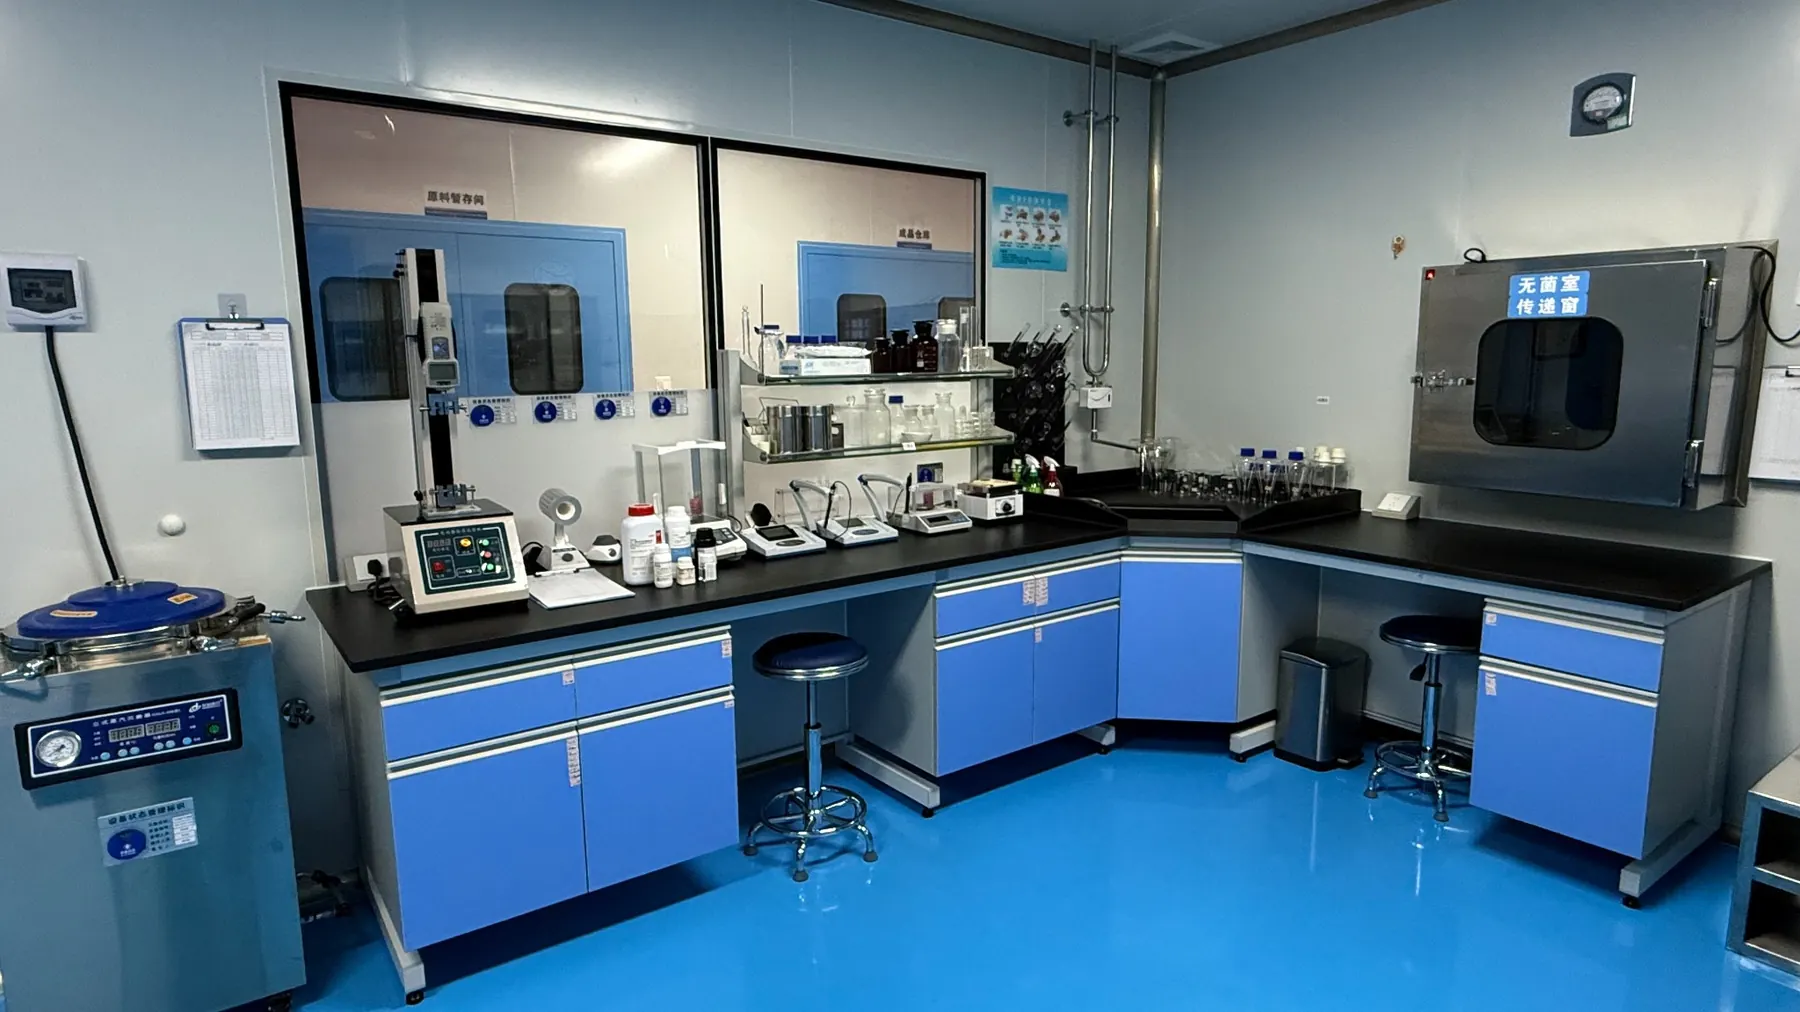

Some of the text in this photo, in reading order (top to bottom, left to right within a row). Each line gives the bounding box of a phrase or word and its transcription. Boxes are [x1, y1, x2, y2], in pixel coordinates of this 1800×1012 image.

[427, 190, 485, 206] 原料暂存间
[1518, 274, 1580, 293] 无菌室
[1516, 297, 1579, 315] 传递窗
[108, 803, 185, 824] 设备状态管理标识
